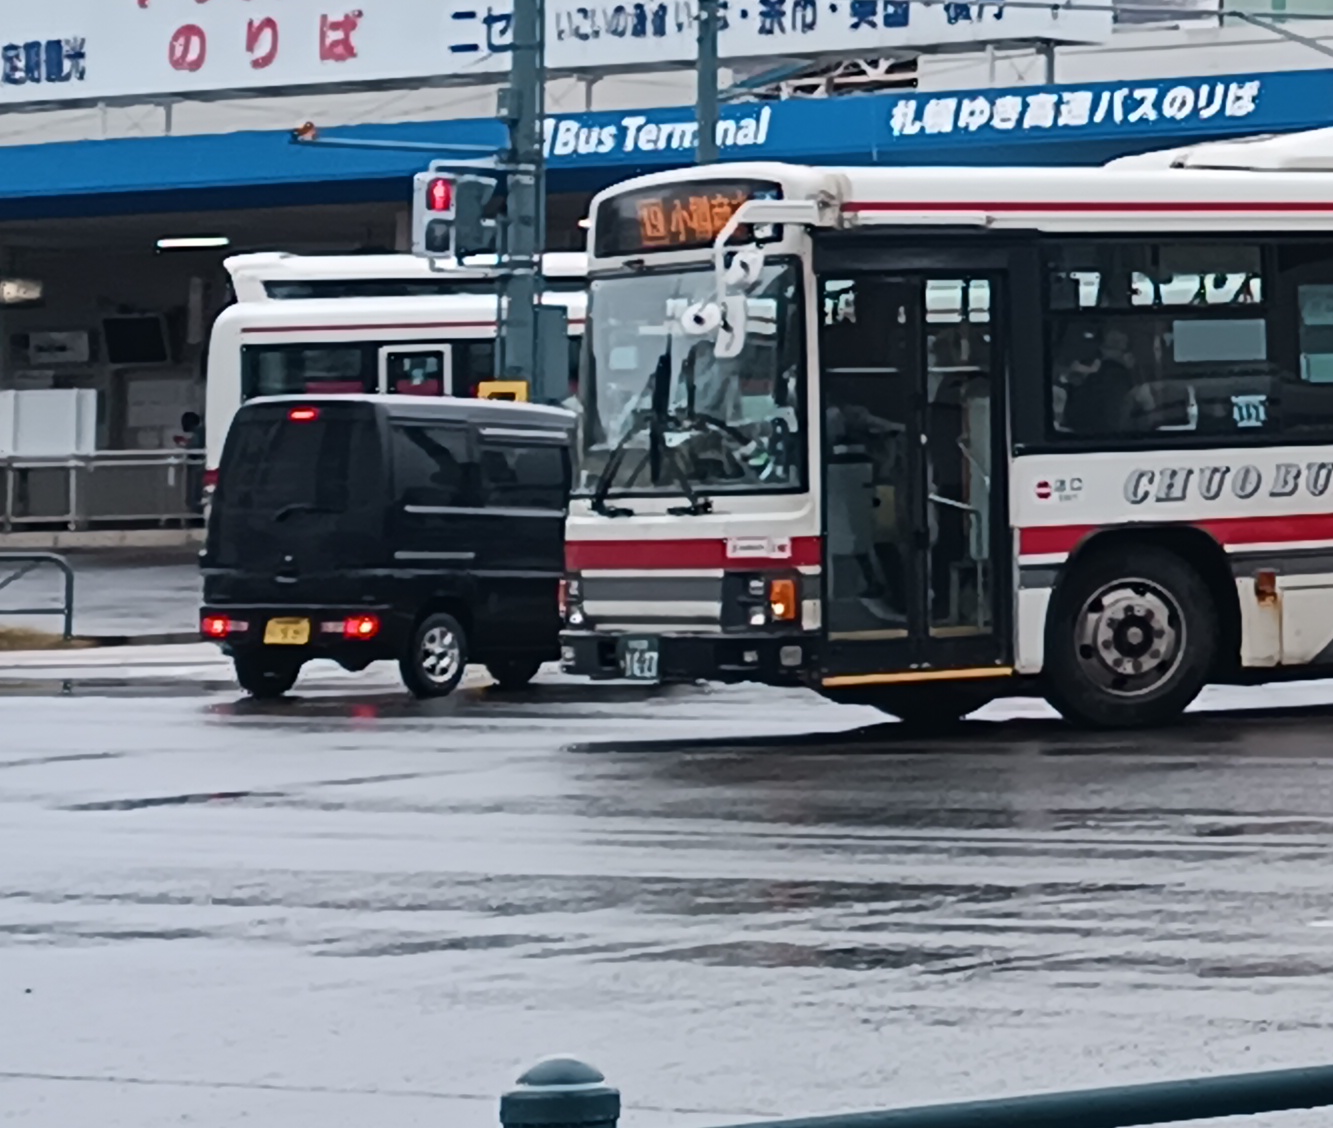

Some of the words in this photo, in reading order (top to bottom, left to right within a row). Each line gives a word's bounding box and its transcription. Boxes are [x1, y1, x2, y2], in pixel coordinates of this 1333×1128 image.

[168, 9, 363, 72] のりば
[553, 119, 618, 156] Bus
[621, 105, 772, 152] Termnal
[889, 80, 1261, 136] 札幌ゆき高速バスのりば
[1122, 464, 1263, 505] CHUO
